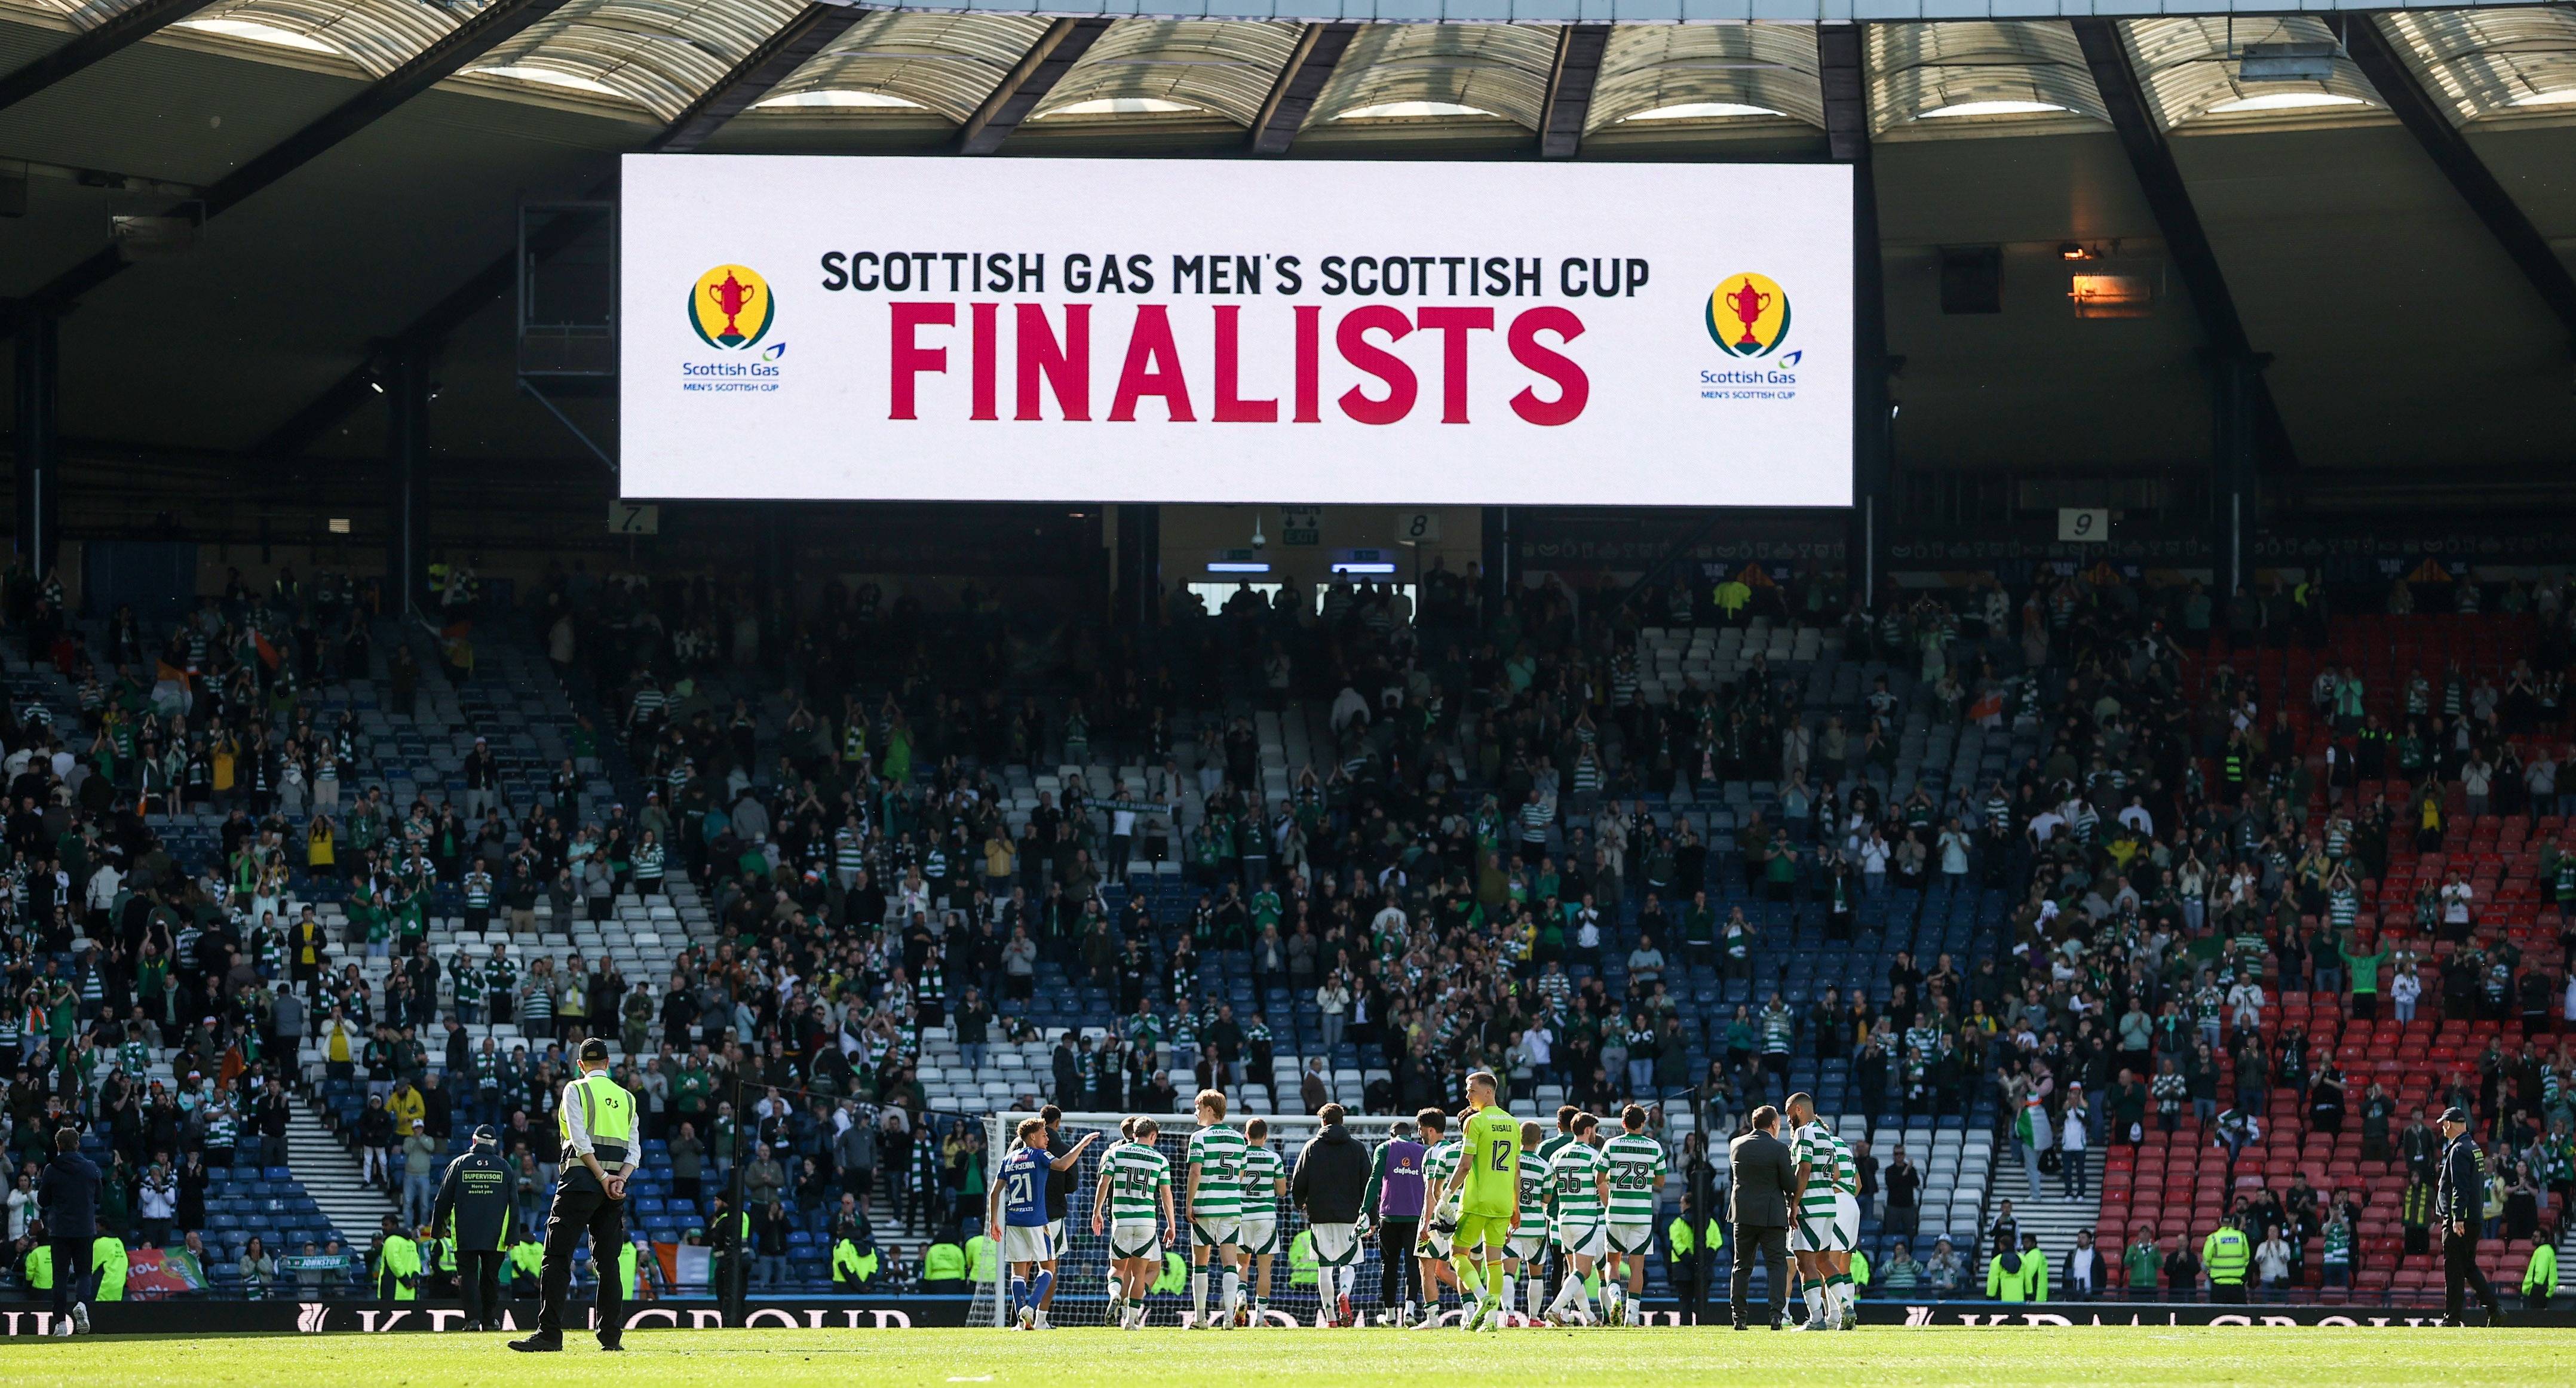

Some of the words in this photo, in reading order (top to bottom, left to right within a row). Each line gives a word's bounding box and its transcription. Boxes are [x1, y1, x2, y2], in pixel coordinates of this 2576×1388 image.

[821, 251, 1044, 294] SCOTTISH
[1065, 253, 1154, 294] GAS
[1173, 253, 1302, 296] MEN'S
[1321, 256, 1541, 297] SCOTTISH
[1562, 257, 1649, 297] CUP
[683, 363, 747, 376] Scottish
[751, 363, 779, 376] Gas
[888, 302, 1589, 426] FINALISTS
[1701, 370, 1763, 383] Scottish
[1767, 370, 1796, 383] Gas
[1410, 514, 1428, 536] 8
[2074, 513, 2092, 536] 9
[1125, 1147, 1155, 1156] MAGNERS
[1492, 1140, 1511, 1171] 12
[1218, 1151, 1234, 1180] 5
[1393, 1166, 1419, 1175] dafabet
[1617, 1161, 1649, 1189] 28
[1010, 1172, 1032, 1204] 21
[1124, 1166, 1151, 1197] 14
[1246, 1171, 1261, 1196] 2
[1556, 1166, 1581, 1193] 56
[302, 1257, 341, 1267] JOHNSTON
